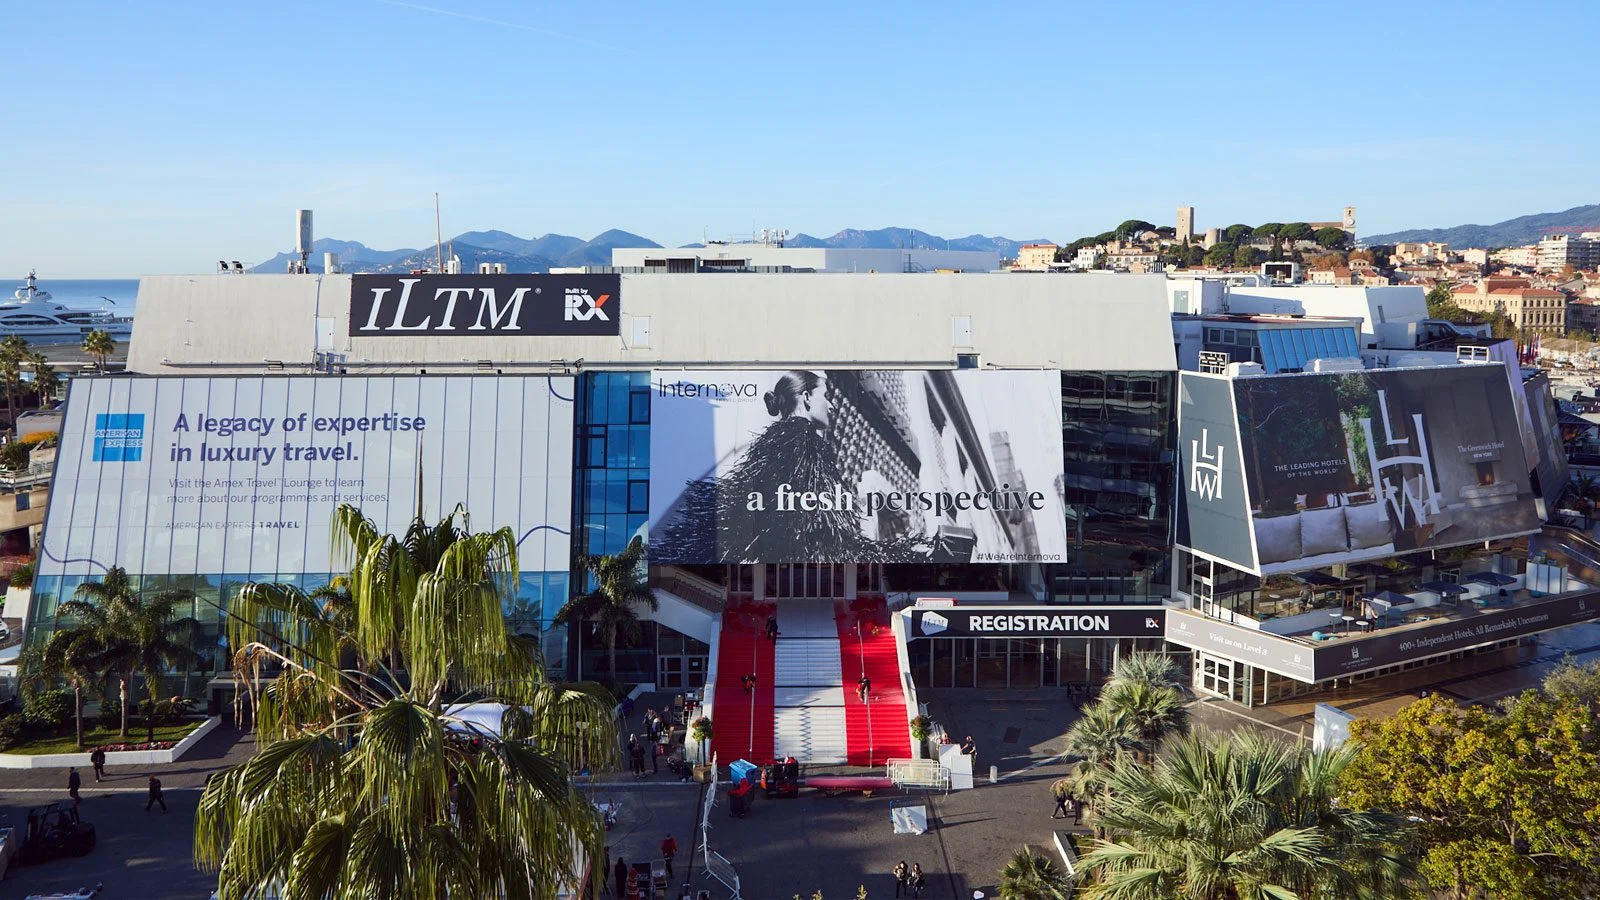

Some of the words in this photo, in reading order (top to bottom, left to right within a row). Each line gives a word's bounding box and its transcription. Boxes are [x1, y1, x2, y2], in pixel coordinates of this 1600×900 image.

[564, 294, 610, 321] RX
[659, 377, 758, 398] Internova
[173, 413, 190, 432] A
[197, 413, 275, 437] legacy
[282, 412, 308, 432] of
[314, 412, 426, 436] expertise
[94, 429, 141, 438] AMERICAN
[103, 439, 144, 448] EXPRESS
[170, 443, 192, 462] in
[200, 442, 277, 466] luxury
[284, 442, 359, 461] travel.
[1274, 464, 1289, 472] THE
[1290, 461, 1320, 471] LEADING
[1321, 458, 1347, 467] HOTELS
[168, 479, 194, 488] Visit
[194, 479, 211, 488] the
[213, 479, 244, 488] Amex
[284, 478, 322, 489] Lounge
[325, 478, 336, 487] to
[338, 478, 365, 487] learn
[167, 494, 195, 504] more
[197, 493, 227, 503] about
[230, 494, 249, 503] our
[250, 493, 319, 505] programmes
[320, 492, 341, 502] and
[343, 491, 389, 503] services.
[745, 490, 766, 512] a
[774, 483, 853, 512] fresh
[866, 482, 1045, 517] perspective
[165, 521, 213, 529] AMERICAN
[215, 521, 256, 529] EXPRESS
[259, 521, 300, 529] TRAVEL
[976, 552, 1061, 561] #WeAreInternova
[969, 615, 1110, 632] REGISTRATION
[1399, 641, 1416, 651] 400+
[1416, 633, 1454, 648] Independent
[1475, 624, 1485, 635] All
[1485, 619, 1517, 633] Remarkably
[1517, 614, 1549, 626] Uncommon
[1209, 632, 1224, 643] Visit
[1233, 640, 1242, 649] on
[1243, 642, 1262, 654] Level
